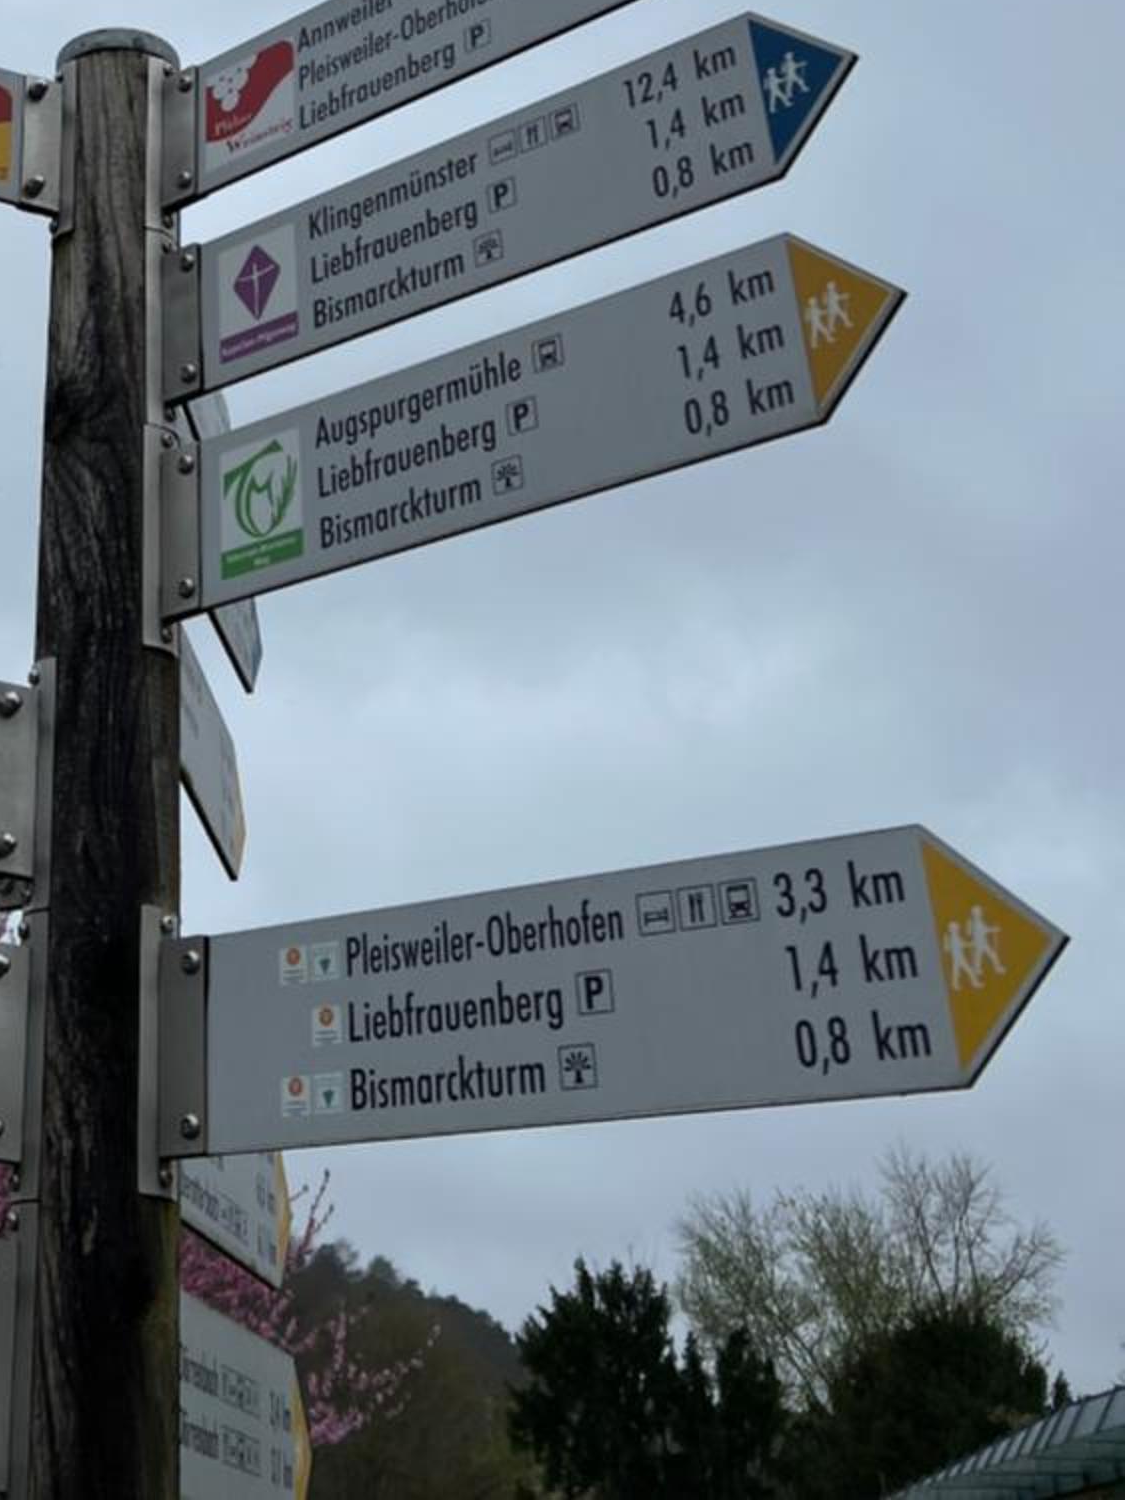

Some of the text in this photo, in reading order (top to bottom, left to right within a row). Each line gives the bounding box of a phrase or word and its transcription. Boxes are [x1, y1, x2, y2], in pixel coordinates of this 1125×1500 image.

[299, 43, 455, 130] Liebfrauenberg
[308, 47, 736, 240] Klingenmünster 12,4 km
[310, 200, 478, 285] Liebfrauenberg
[646, 108, 686, 151] 1,4
[701, 94, 745, 127] km
[313, 142, 754, 329] Bismarckturm 0,8 km
[315, 270, 775, 449] Augspurgermühle 4,6 km
[317, 420, 496, 498] Liebfrauenberg
[677, 334, 720, 381] 1,4
[736, 324, 785, 360] km
[320, 378, 794, 549] Bismarckturm 0,8 km
[346, 860, 905, 978] Pleisweiler-Oberhofen 3,3 km
[348, 980, 564, 1043] Liebfrauenberg
[784, 940, 839, 999] 1,4
[859, 933, 919, 983] km
[350, 1009, 932, 1111] Bismarckturm 0,8 km
